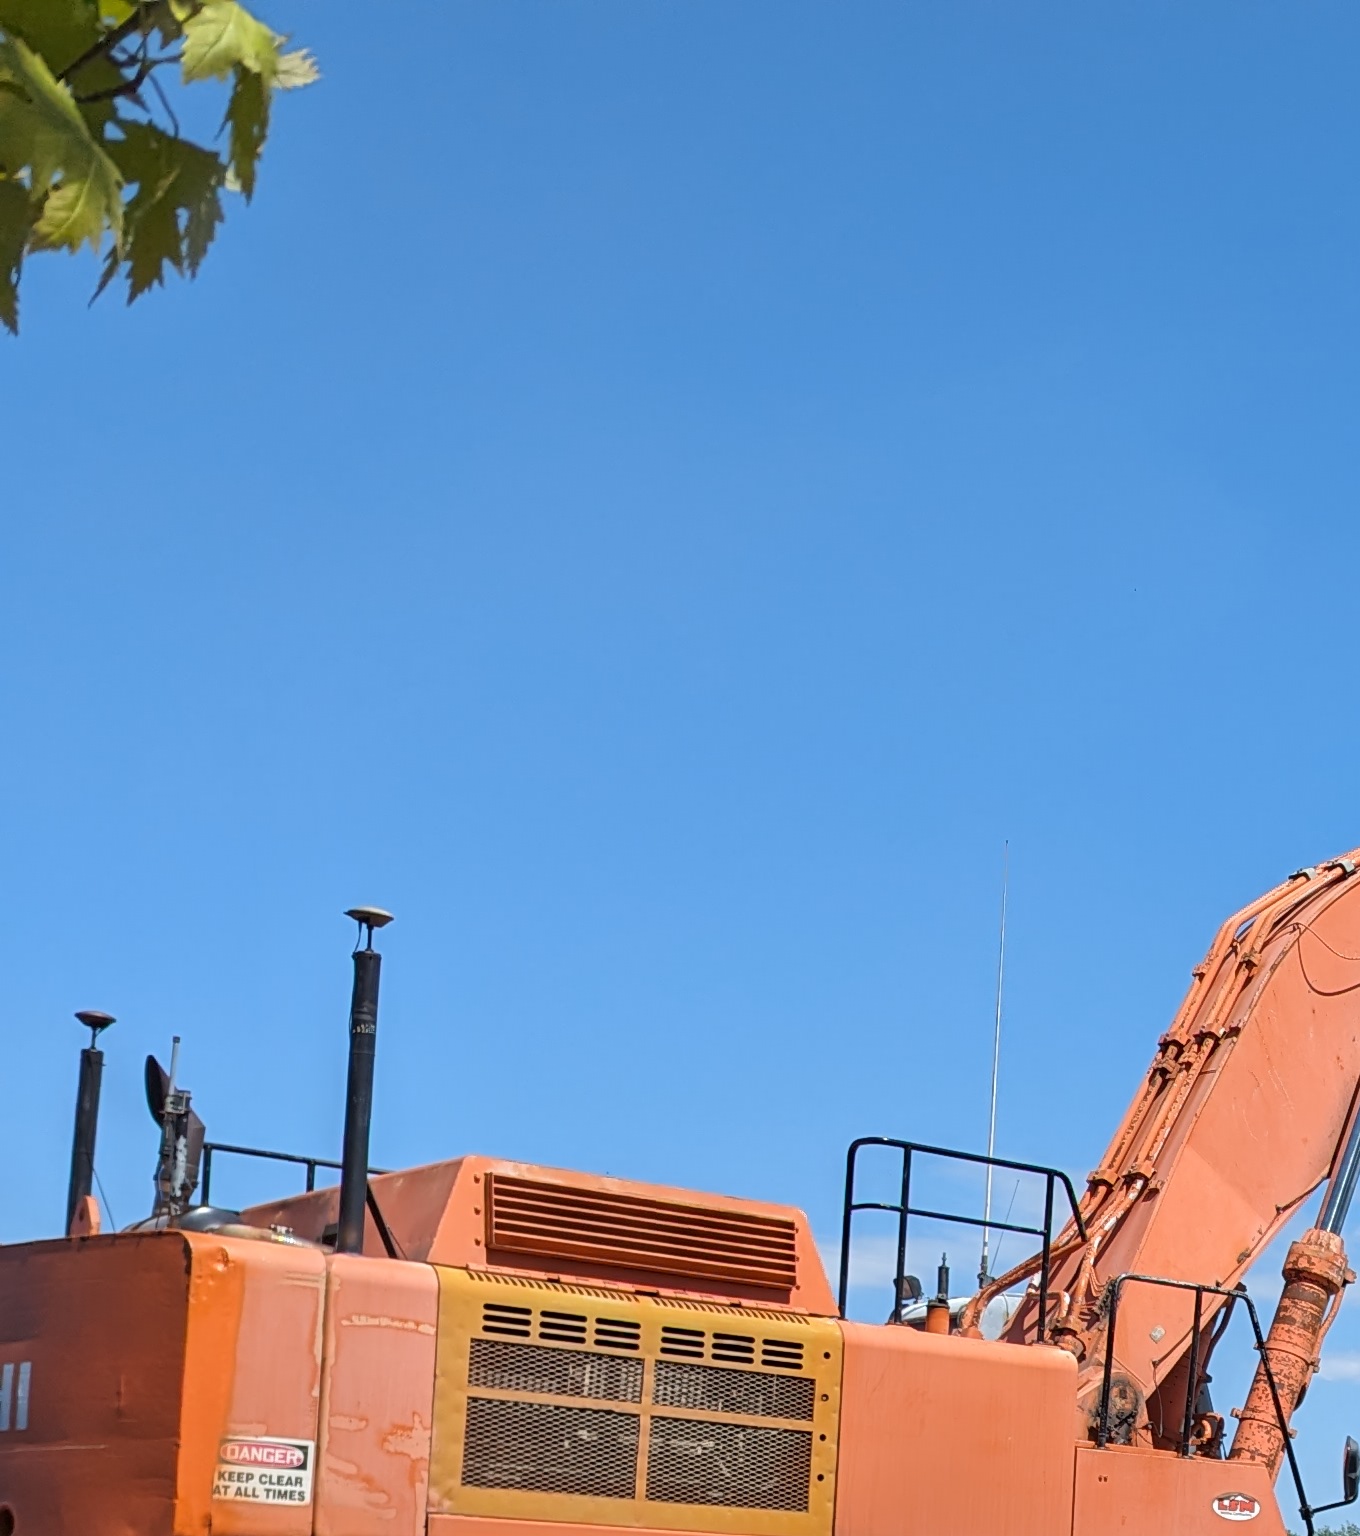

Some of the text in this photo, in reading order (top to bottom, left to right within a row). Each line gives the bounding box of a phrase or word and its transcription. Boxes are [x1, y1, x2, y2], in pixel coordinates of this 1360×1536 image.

[226, 1445, 299, 1466] DANGER
[217, 1470, 303, 1487] KEEP CLEAR
[213, 1485, 306, 1502] AT ALL TIMES
